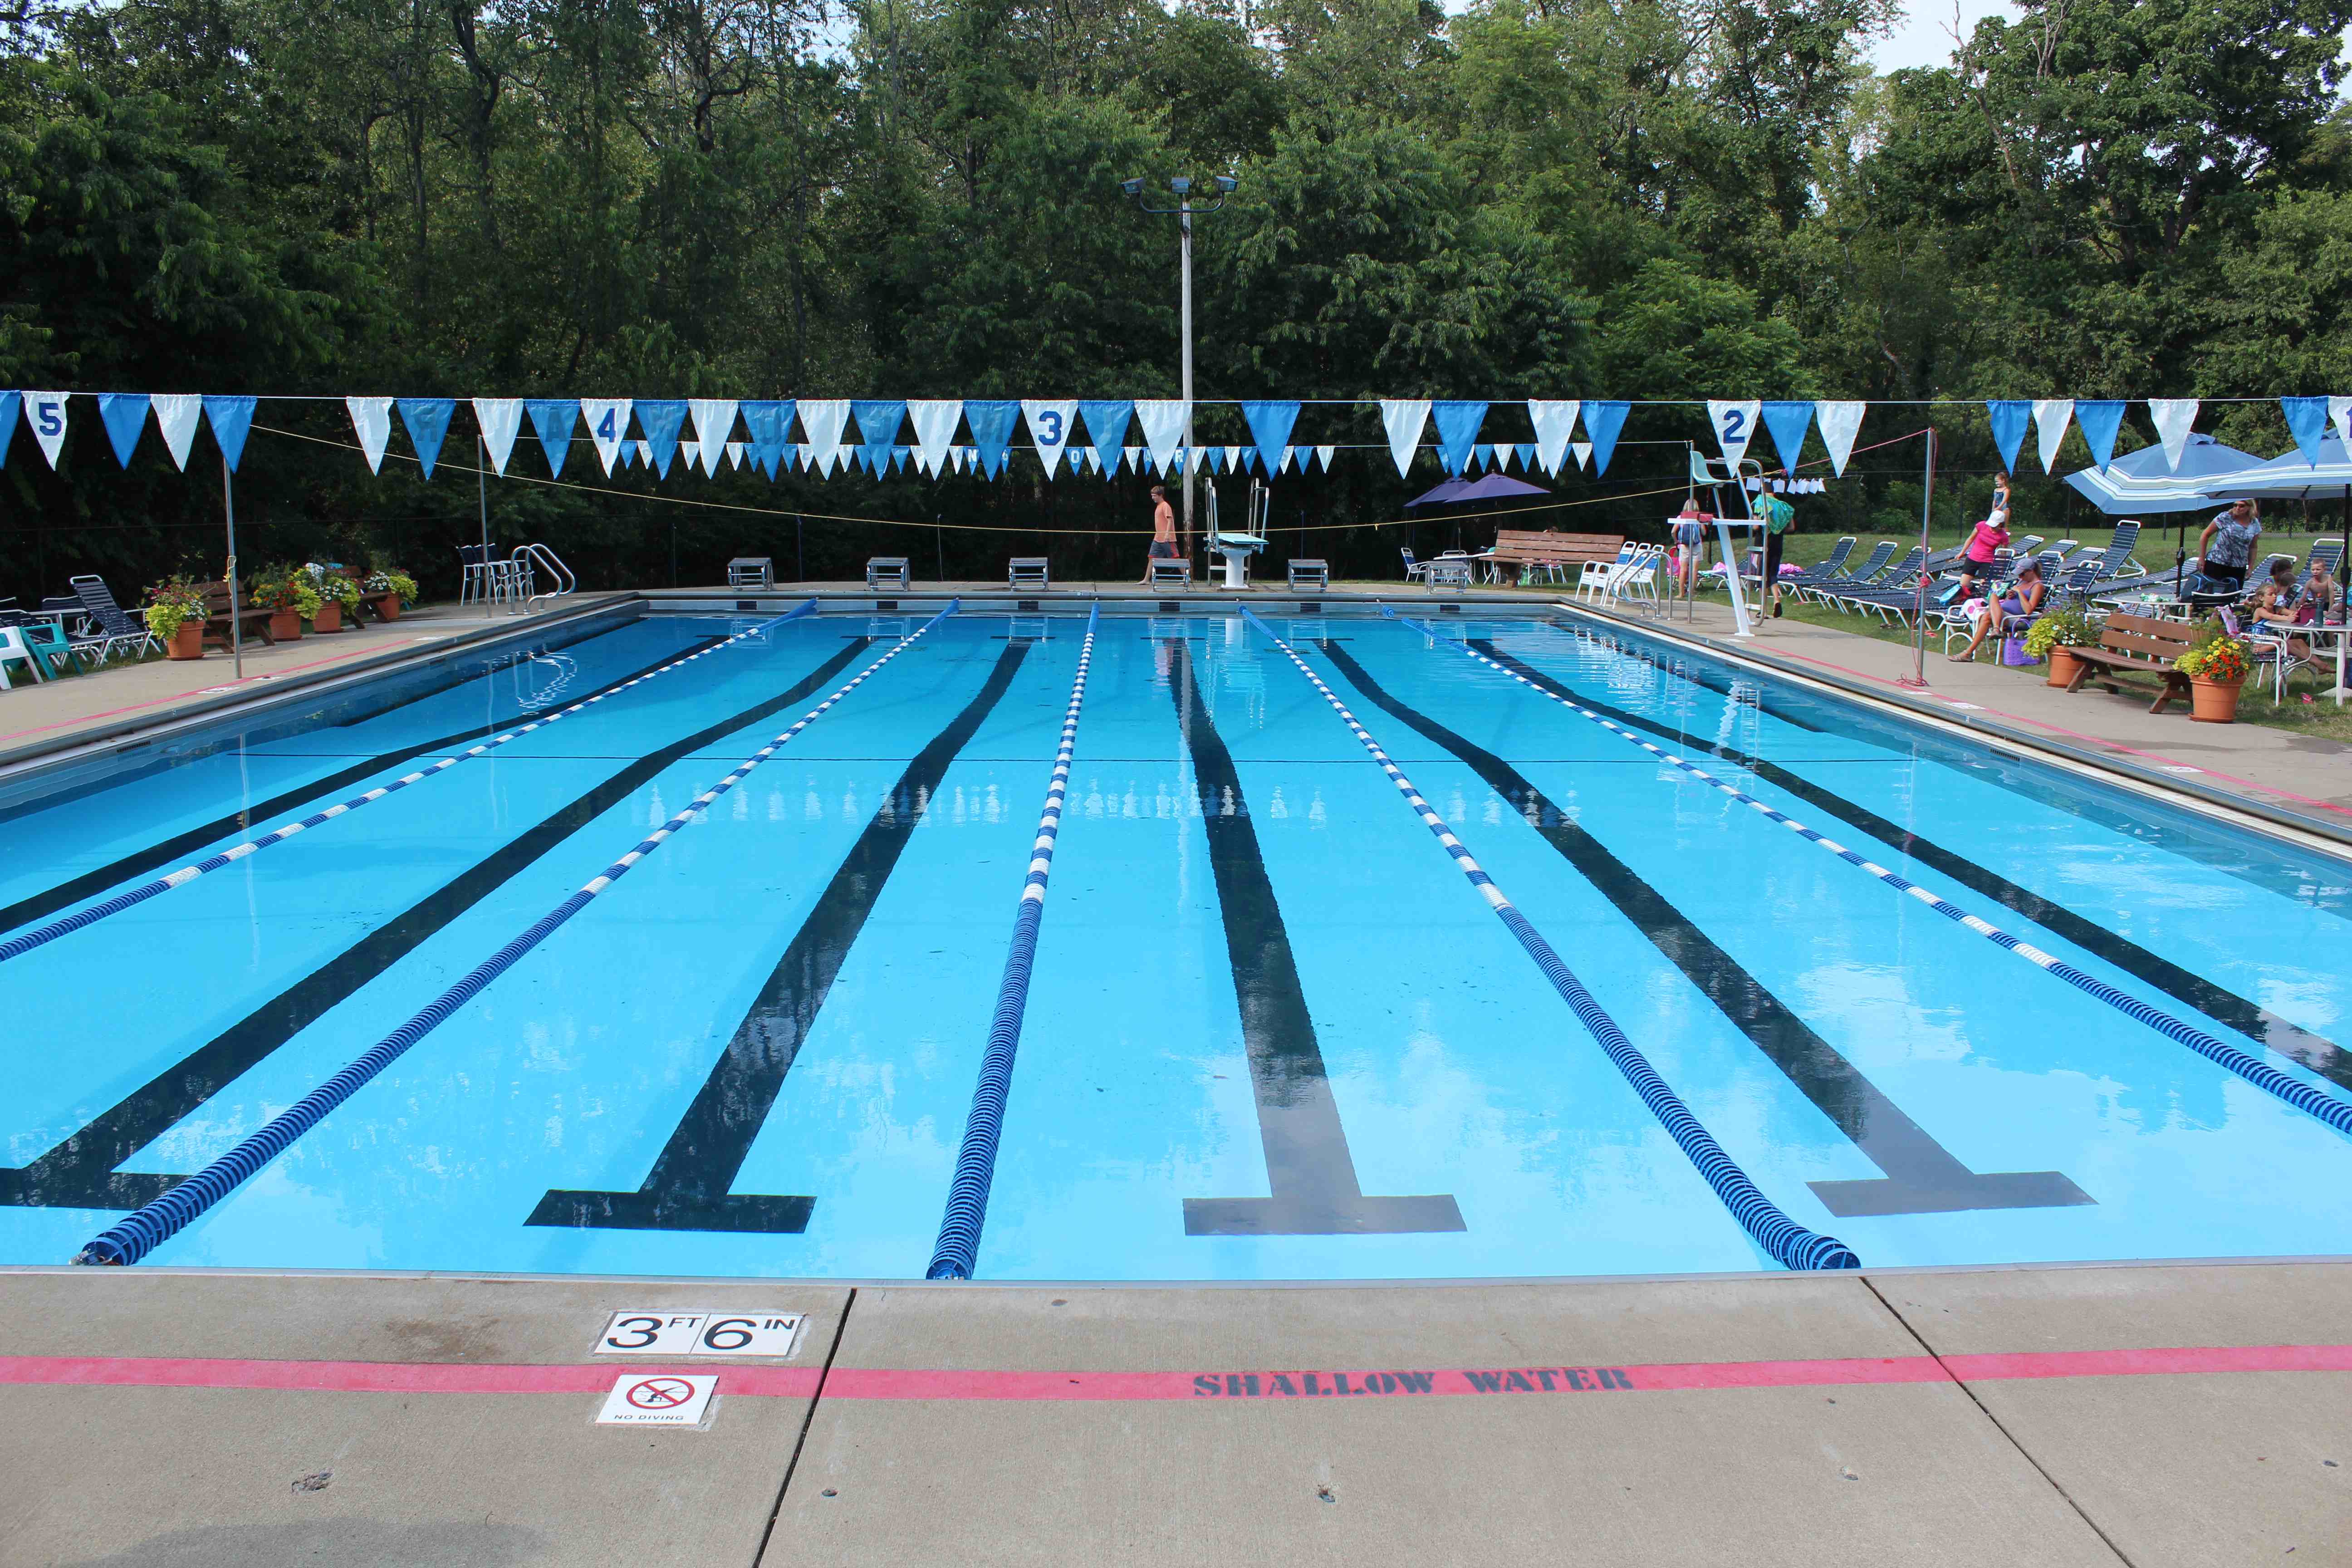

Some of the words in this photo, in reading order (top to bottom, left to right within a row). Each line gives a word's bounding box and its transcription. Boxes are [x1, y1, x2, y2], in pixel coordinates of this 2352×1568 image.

[39, 402, 62, 436] 5
[597, 409, 616, 443] 4
[1038, 411, 1062, 446] 3
[1723, 410, 1745, 443] 2
[968, 449, 977, 462] N
[1146, 449, 1152, 462] A
[1175, 450, 1184, 463] R
[607, 1317, 662, 1348] 3
[668, 1318, 701, 1328] FT
[704, 1319, 757, 1349] 6
[764, 1319, 795, 1329] IN
[1193, 1372, 1435, 1396] SHALLOW
[1464, 1367, 1632, 1392] WATER
